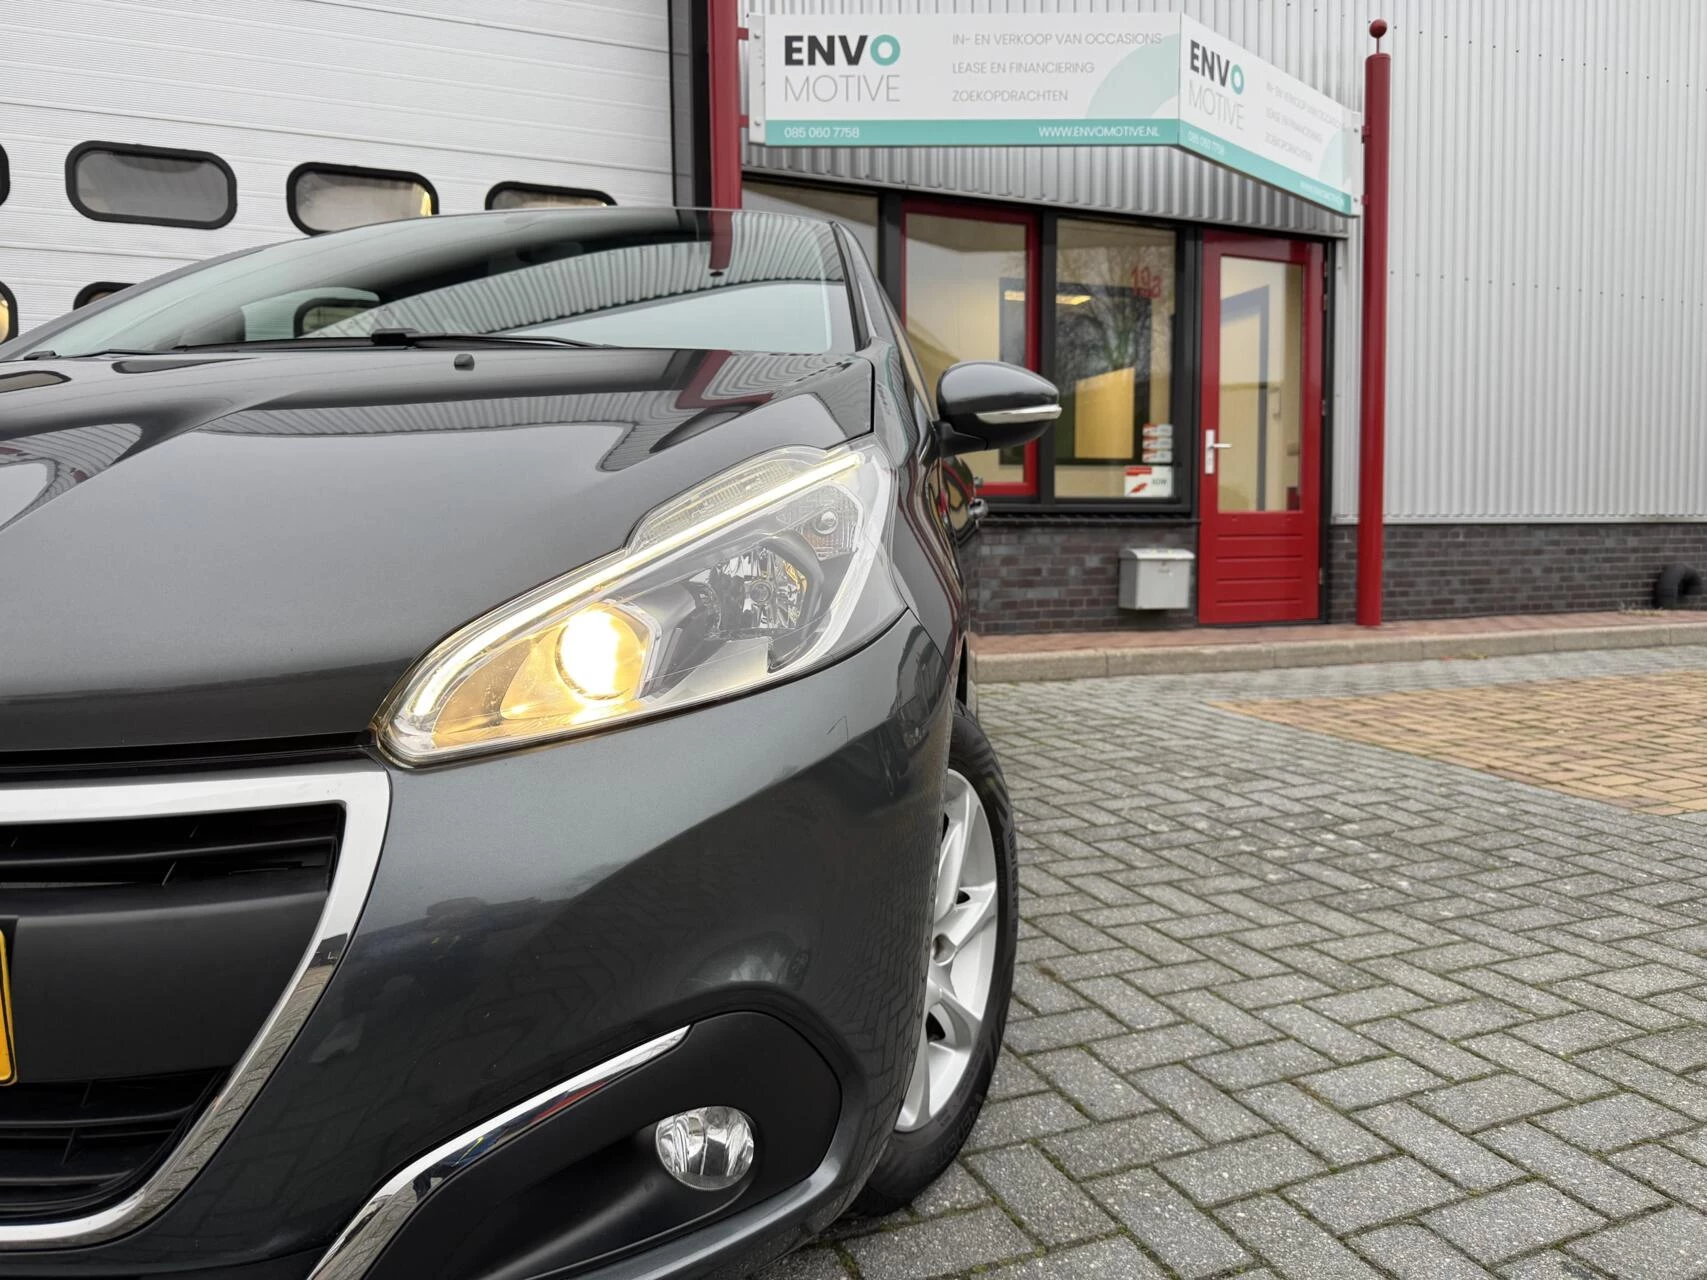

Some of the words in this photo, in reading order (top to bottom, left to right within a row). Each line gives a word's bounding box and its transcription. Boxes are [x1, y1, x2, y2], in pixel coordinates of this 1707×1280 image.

[974, 34, 990, 45] EN
[993, 33, 1052, 45] VERKOOP
[1055, 33, 1082, 45] VAN
[1085, 32, 1162, 45] OCCASIONS
[784, 34, 901, 66] ENVO
[952, 62, 987, 74] LEASE
[990, 62, 1006, 74] EN
[1009, 62, 1095, 74] FINANCIERING
[1190, 39, 1245, 95] ENVO
[784, 74, 901, 103] MOTIVE
[952, 90, 1068, 101] ZOEKOPDRACHTEN
[1188, 79, 1245, 131] MOTIVE
[784, 127, 806, 138] 085
[808, 127, 831, 138] 060
[832, 127, 860, 138] 7758
[1038, 126, 1160, 137] WWW.ENVOMOTIVE.NL
